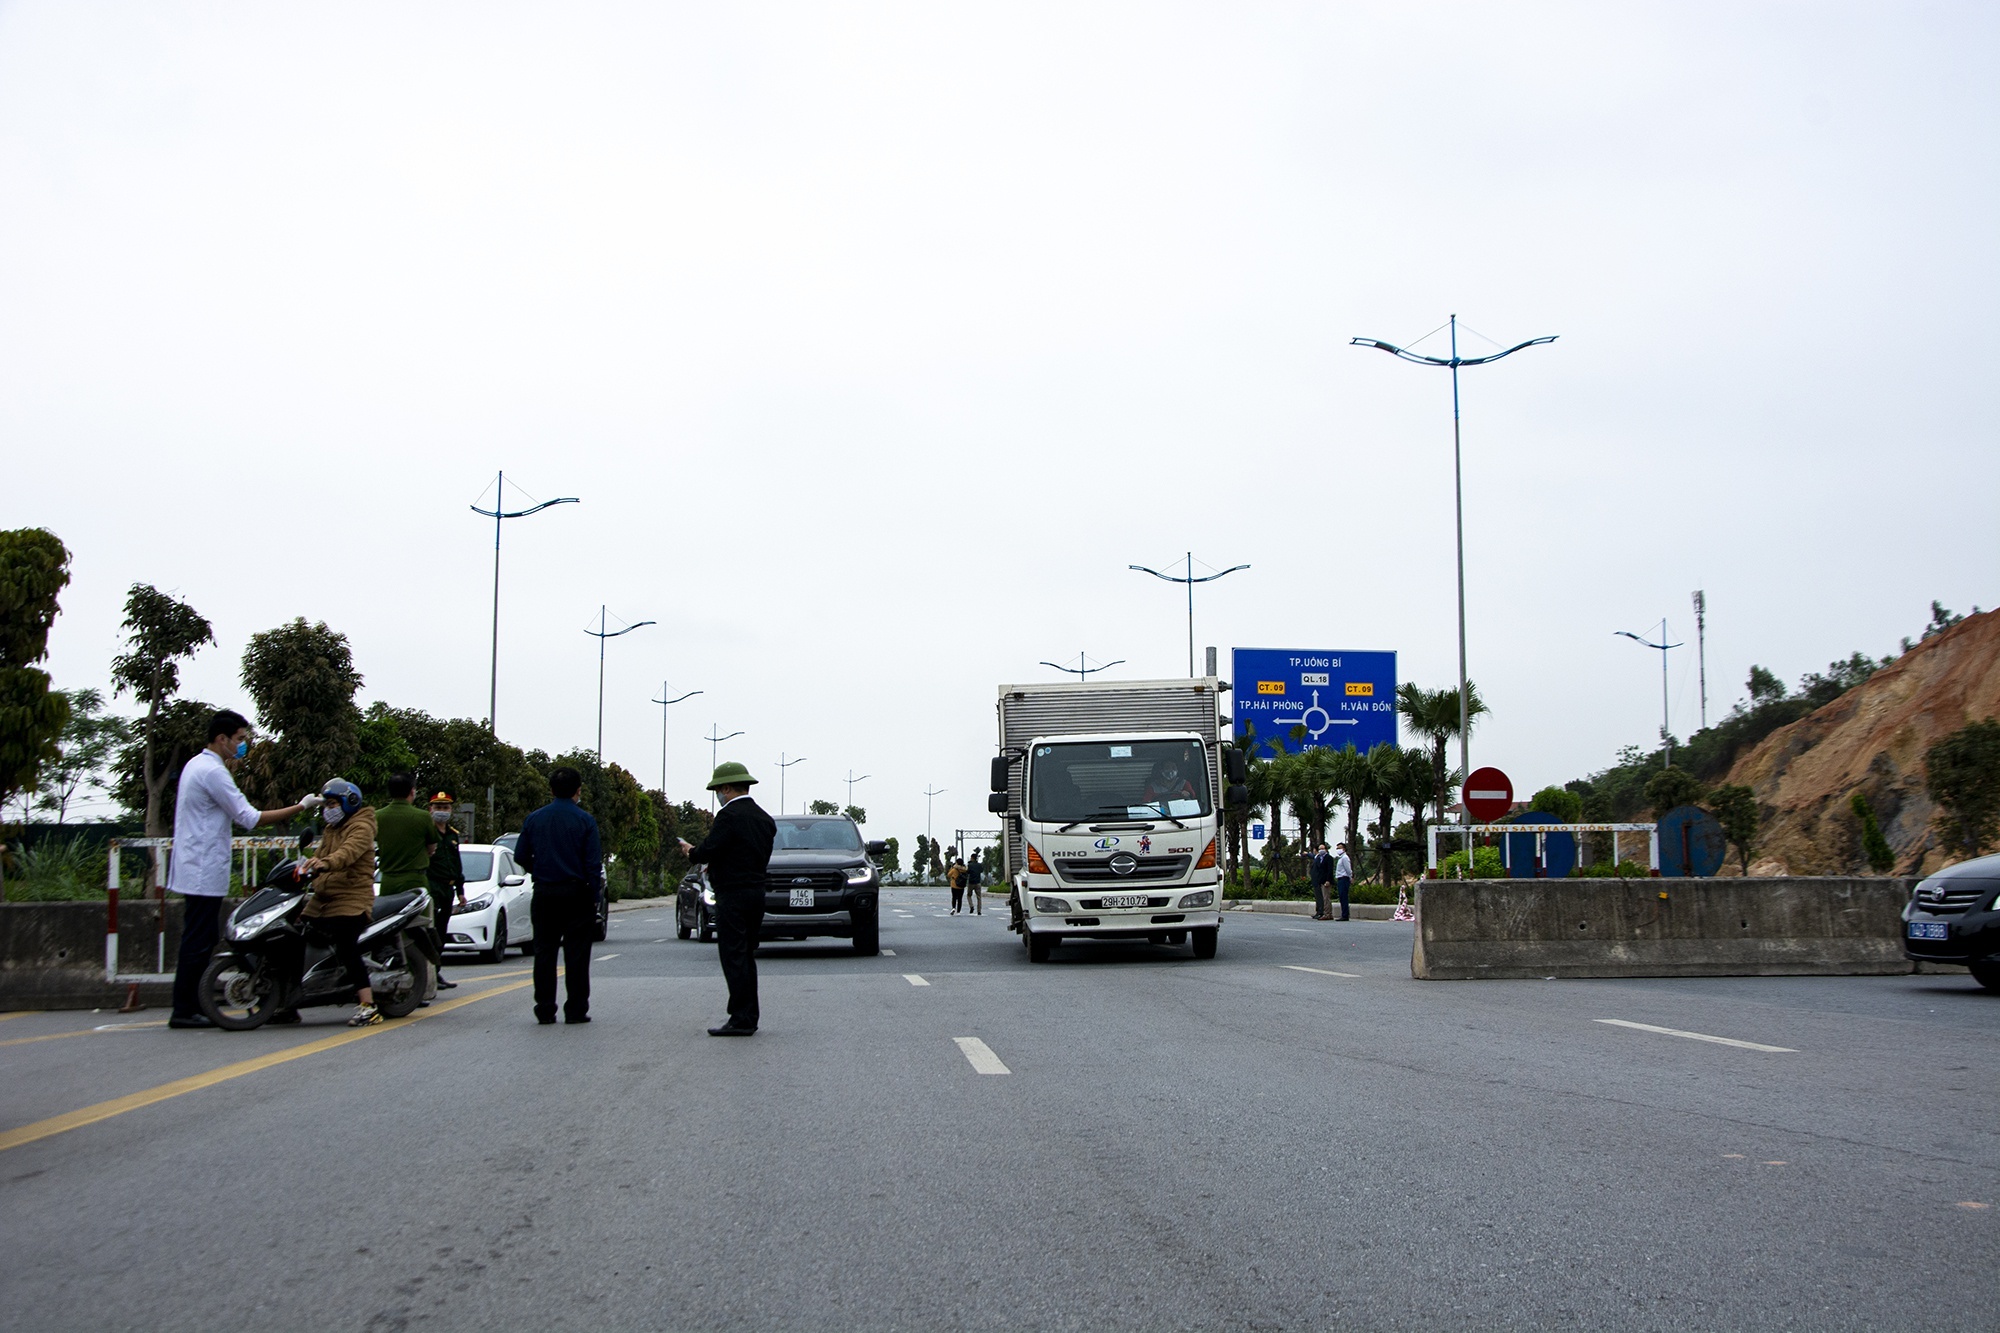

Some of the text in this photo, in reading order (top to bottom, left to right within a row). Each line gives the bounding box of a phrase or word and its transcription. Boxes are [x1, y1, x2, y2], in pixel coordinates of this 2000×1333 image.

[1289, 656, 1329, 668] TP.UÔNG
[1303, 675, 1327, 683] QL.18
[1258, 684, 1284, 692] CT.09
[1346, 685, 1372, 693] CT.09
